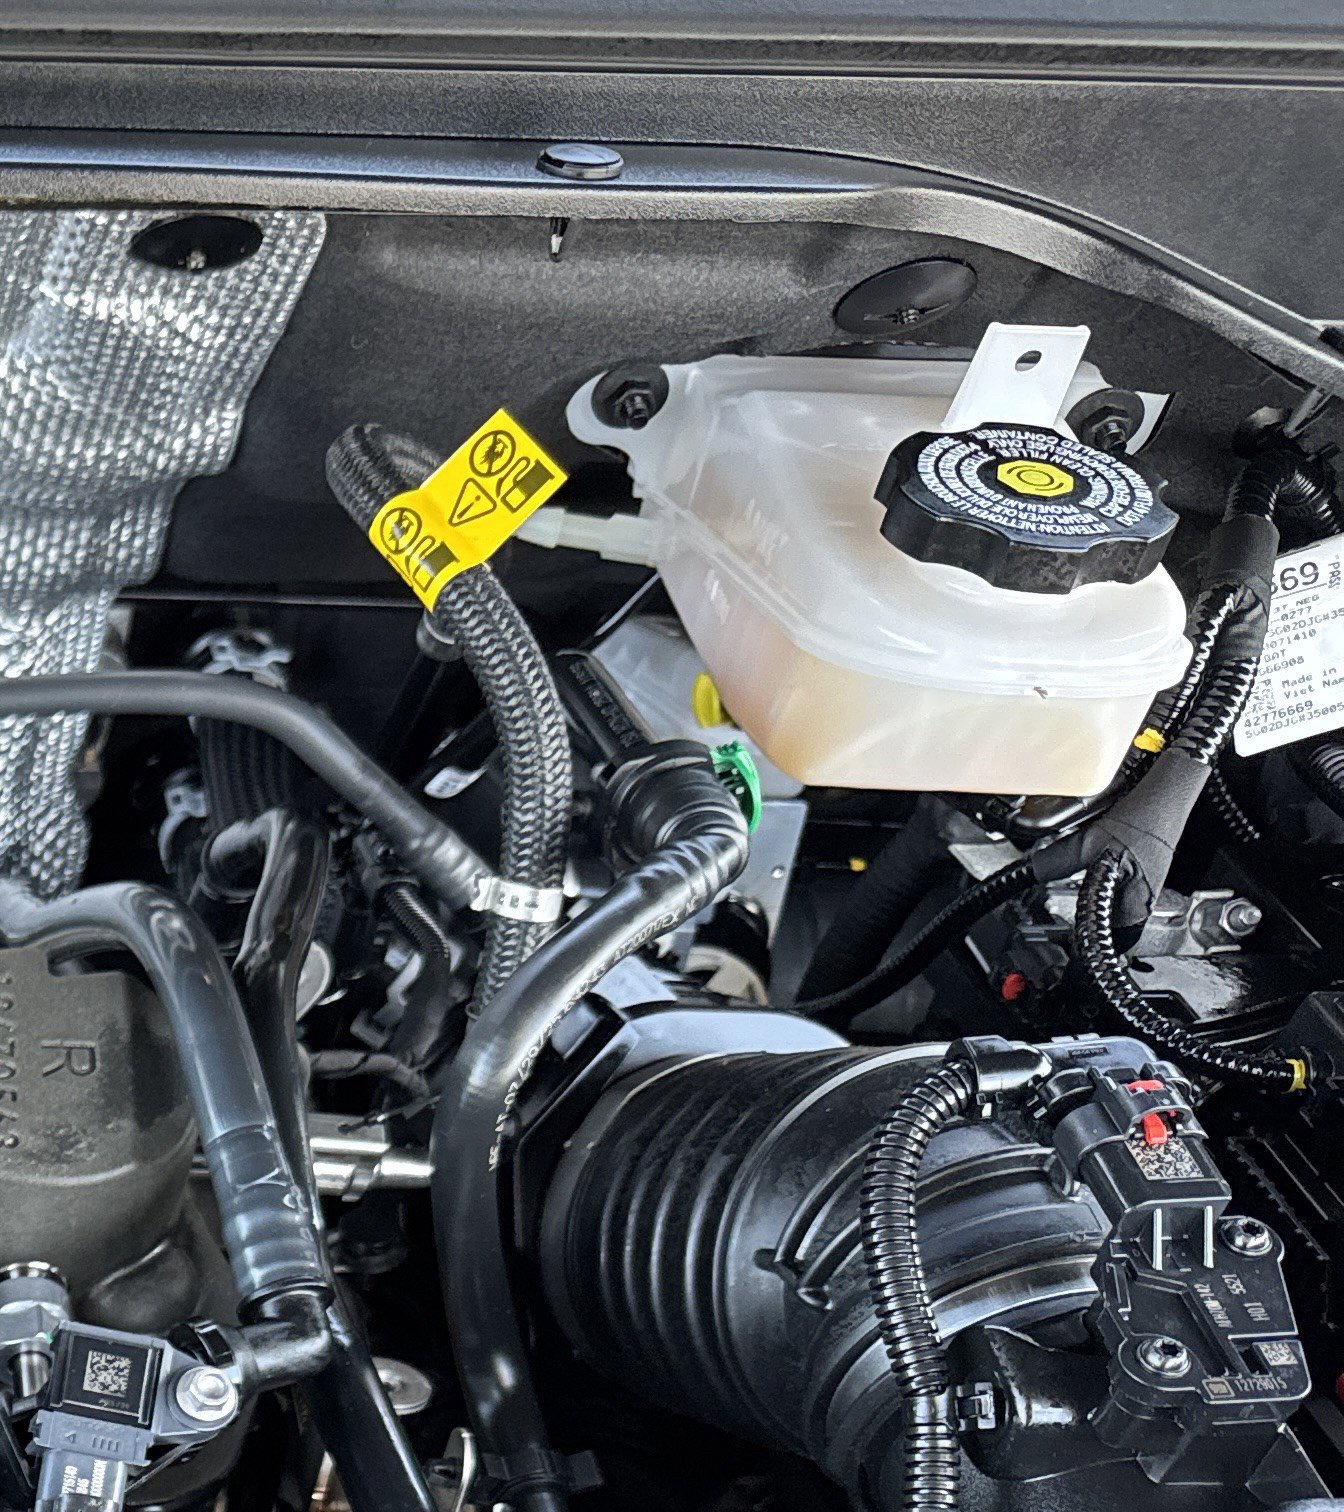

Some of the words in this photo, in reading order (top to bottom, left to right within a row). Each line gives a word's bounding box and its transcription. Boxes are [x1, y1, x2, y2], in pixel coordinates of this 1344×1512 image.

[979, 438, 1024, 448] ONLY
[1025, 440, 1056, 452] USE
[1057, 438, 1118, 463] SEALED
[1048, 454, 1099, 476] CLEAN
[987, 503, 1018, 517] QUE
[998, 497, 1084, 514] PROVENANT
[965, 506, 1035, 532] NETTOYER
[1282, 674, 1312, 688] Made
[1323, 667, 1337, 677] in
[1284, 684, 1314, 700] Viet
[1244, 700, 1313, 728] 42776669
[41, 1040, 96, 1078] R
